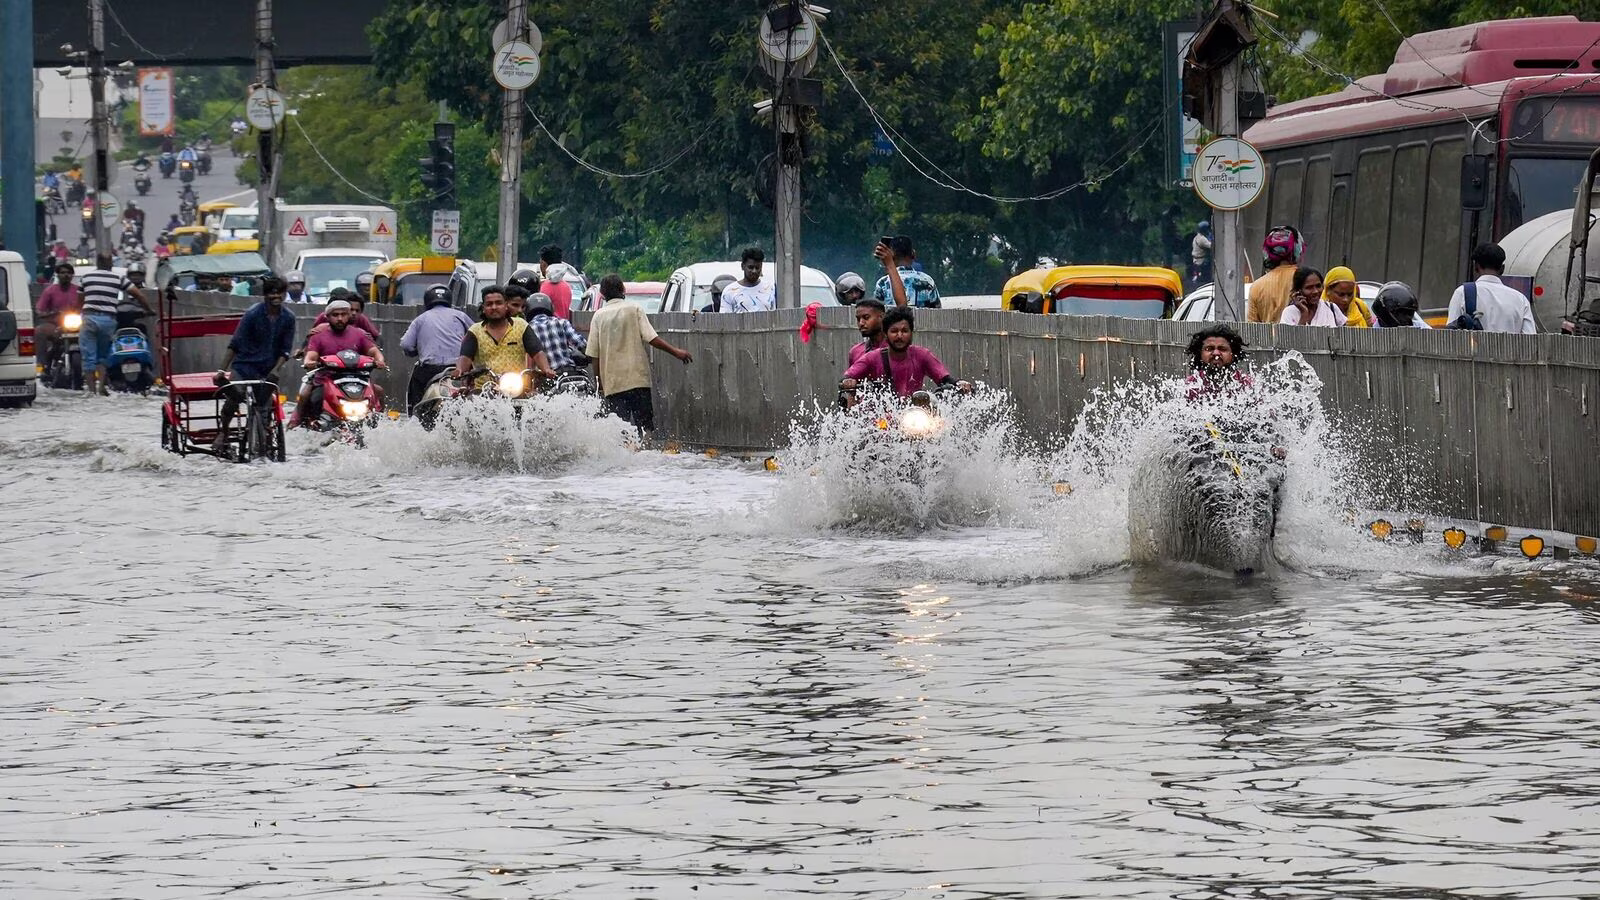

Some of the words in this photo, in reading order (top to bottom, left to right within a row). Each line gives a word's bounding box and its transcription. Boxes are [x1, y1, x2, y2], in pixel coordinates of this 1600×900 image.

[1205, 155, 1225, 171] 75
[1201, 173, 1227, 183] आज़ादी
[1209, 182, 1227, 192] अमृत
[1229, 181, 1256, 190] महोत्सव
